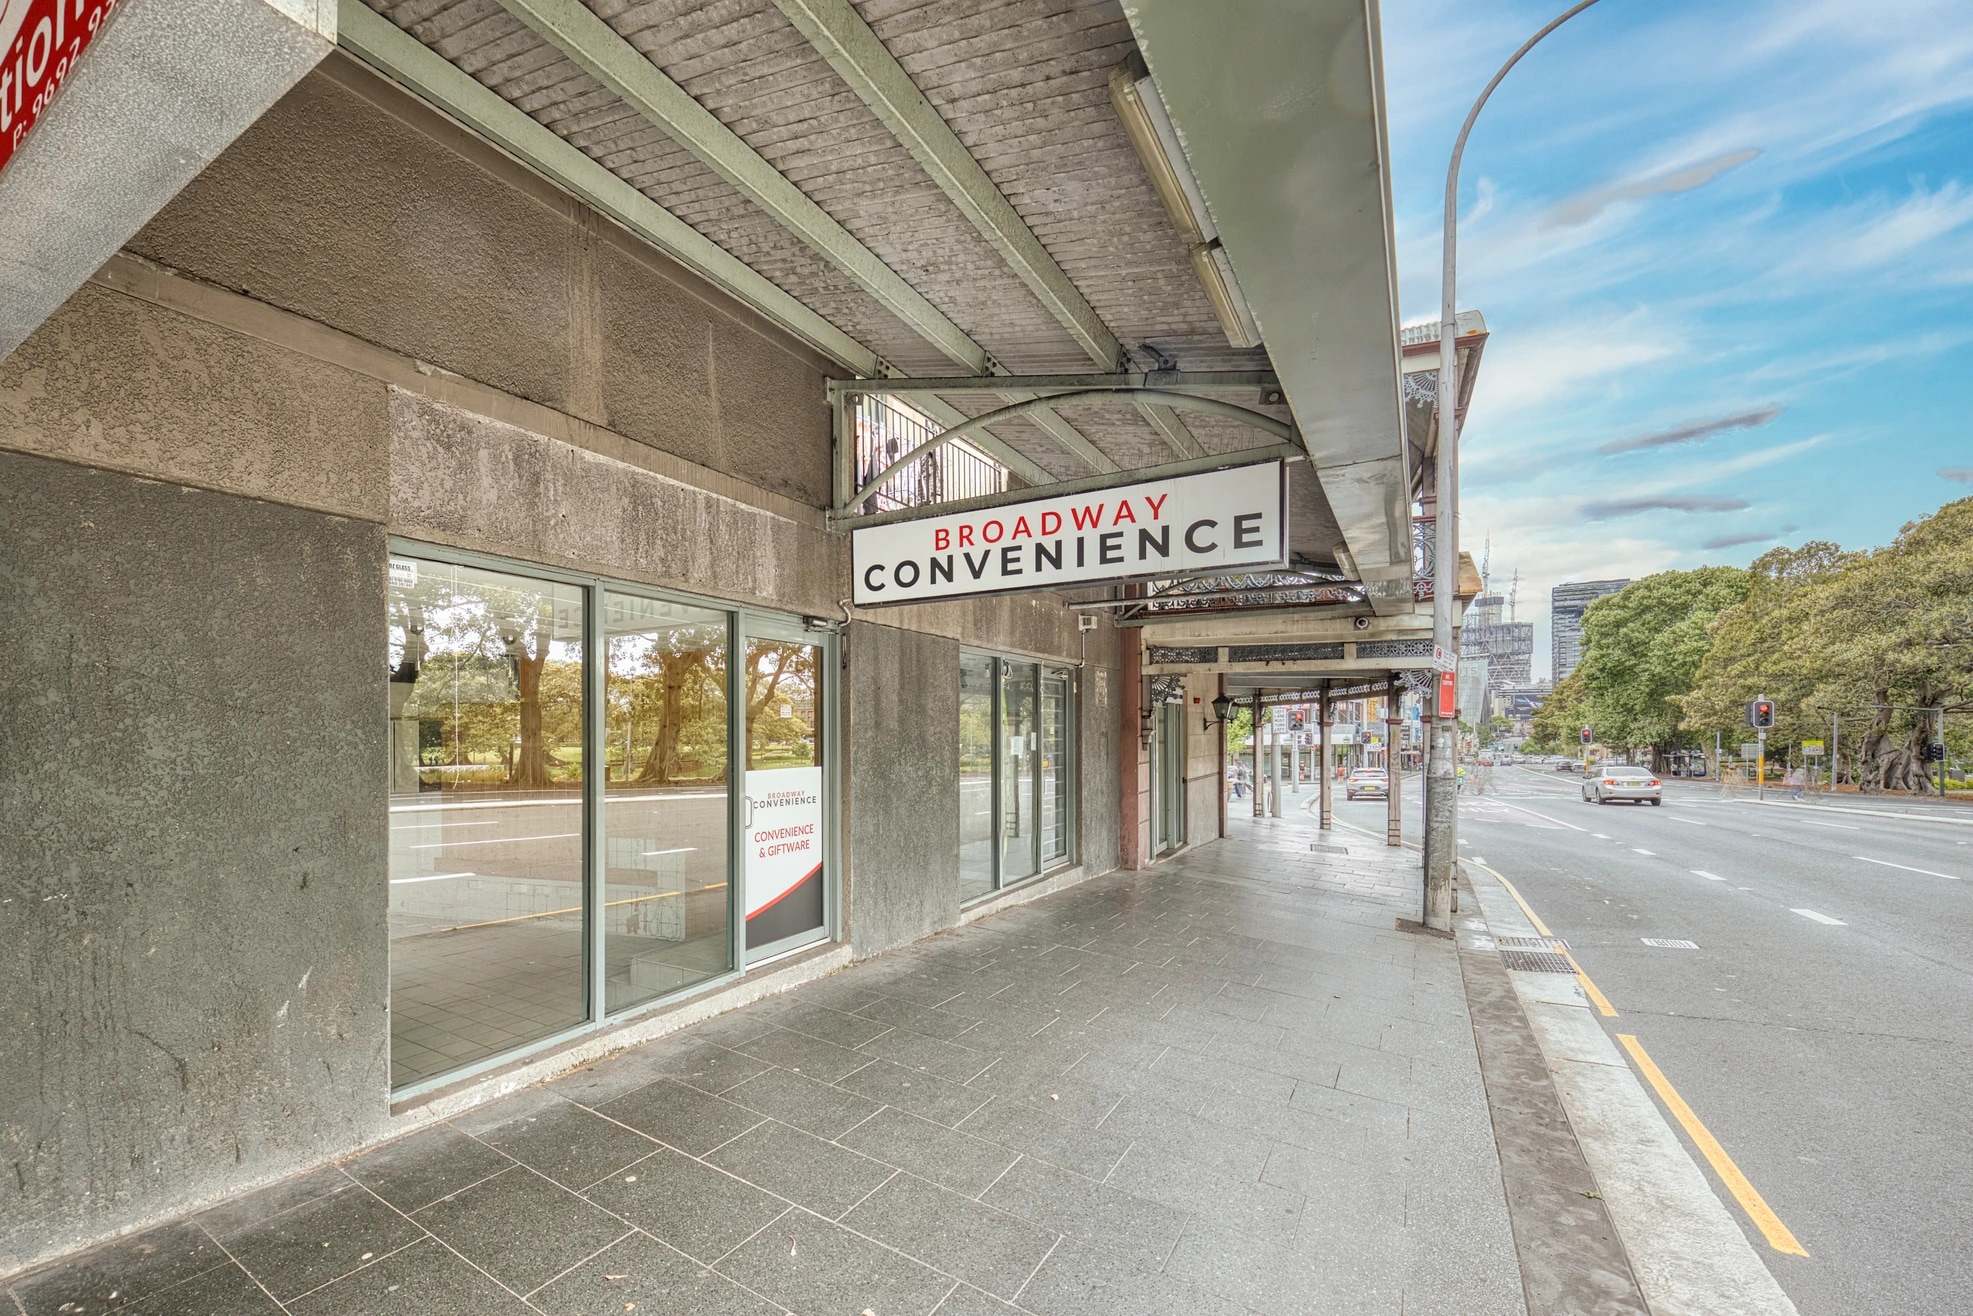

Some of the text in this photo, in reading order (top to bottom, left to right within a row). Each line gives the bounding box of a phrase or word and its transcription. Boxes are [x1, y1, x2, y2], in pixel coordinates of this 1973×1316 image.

[32, 36, 80, 119] 9692
[934, 493, 1168, 551] BROADWAY
[863, 511, 1264, 592] CONVENIENCE
[753, 796, 817, 809] CONVENIENCE
[767, 790, 806, 800] BROADWAY
[754, 824, 814, 843] CONVENIENCE
[759, 839, 810, 858] & GIFTWARE
